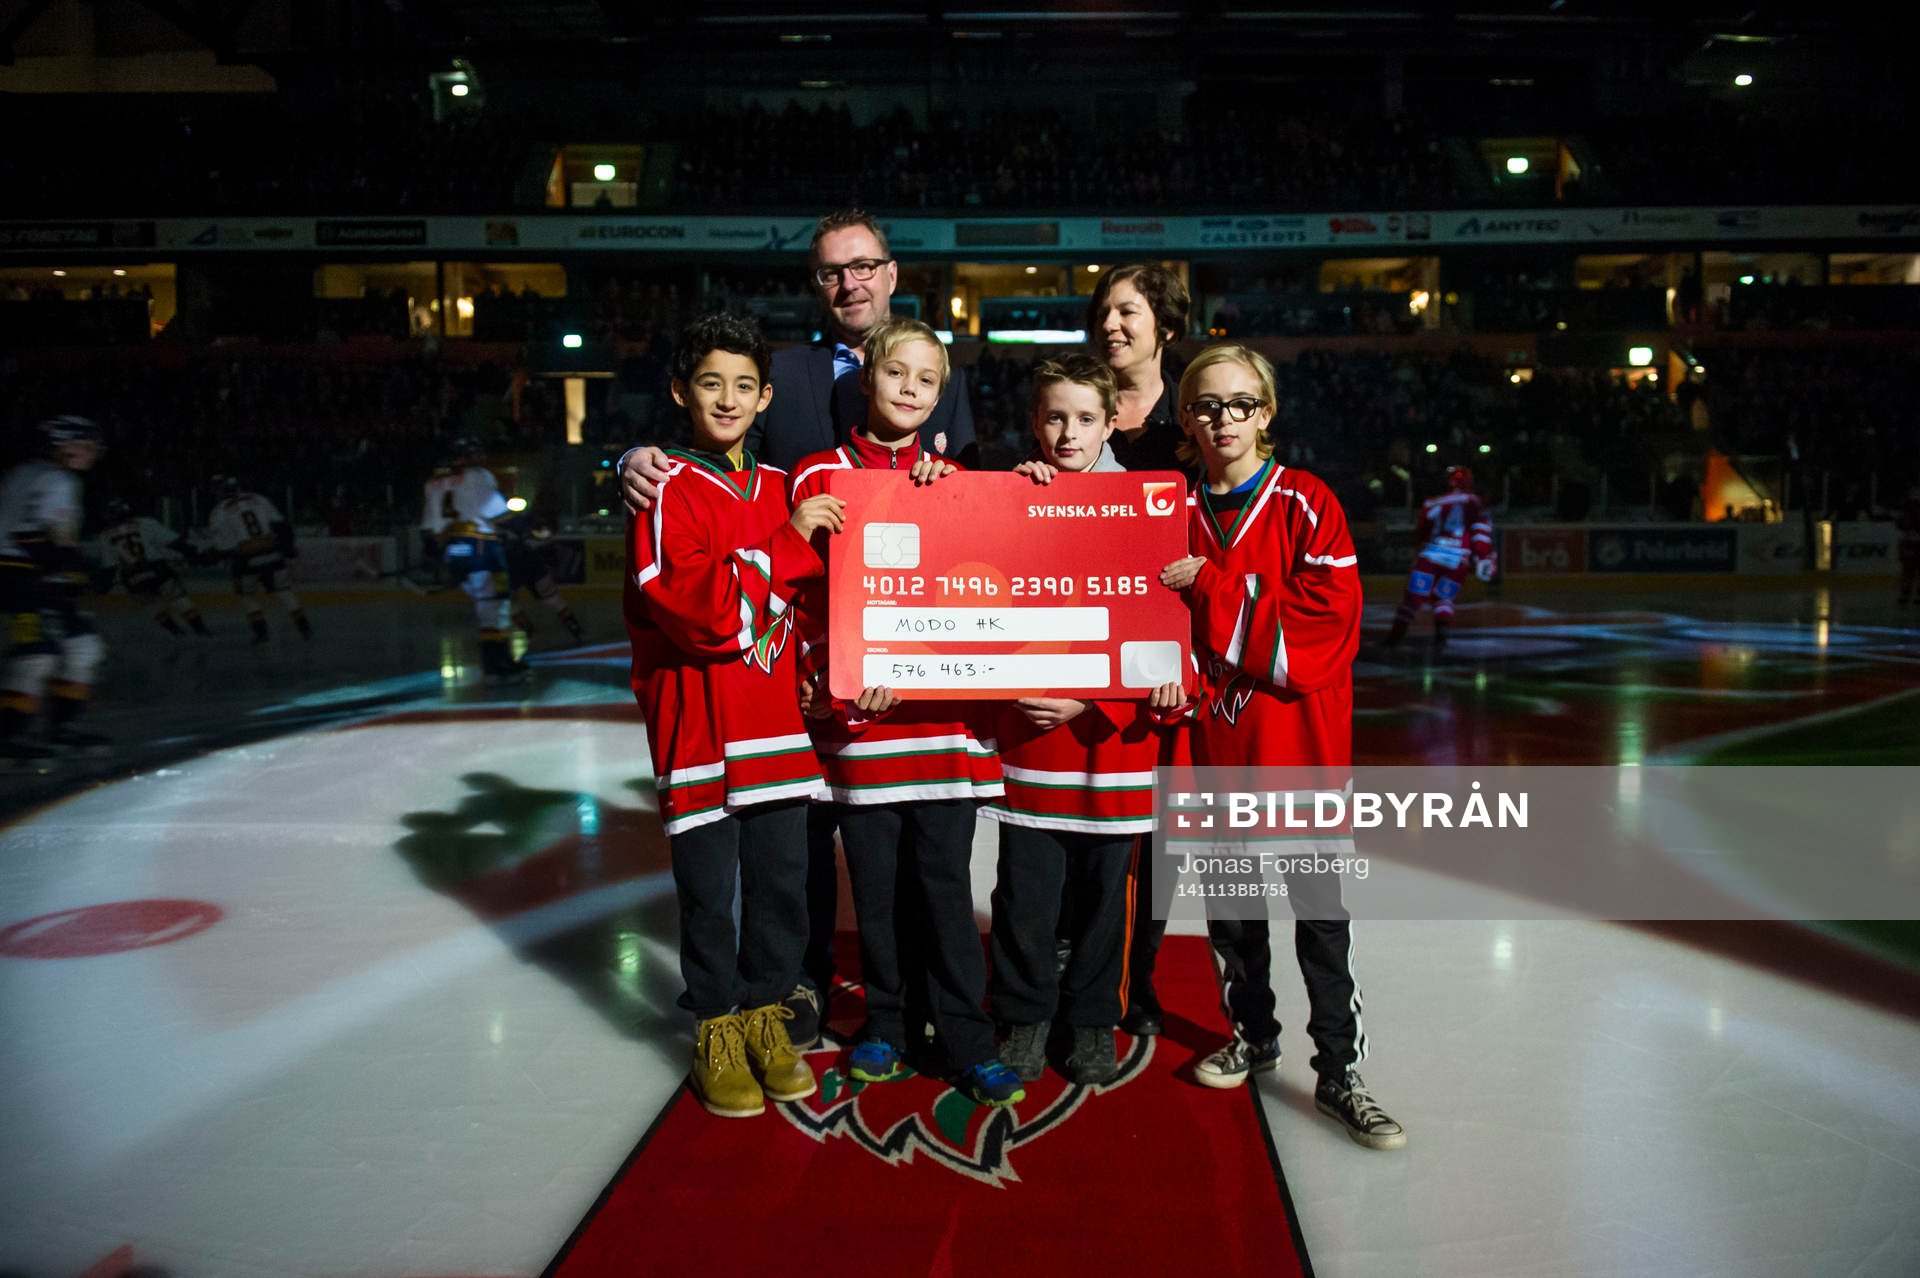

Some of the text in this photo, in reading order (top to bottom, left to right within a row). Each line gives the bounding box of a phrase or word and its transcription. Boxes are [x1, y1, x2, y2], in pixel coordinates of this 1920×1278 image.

[600, 225, 685, 239] EUROCON
[1485, 218, 1560, 232] ANYTEC
[1200, 231, 1307, 244] CARSTEDTS
[1028, 505, 1137, 517] SVENSKA SPEL
[863, 575, 1148, 596] 4012 7496 2390 5185
[895, 618, 956, 633] MODO
[892, 664, 926, 678] 576
